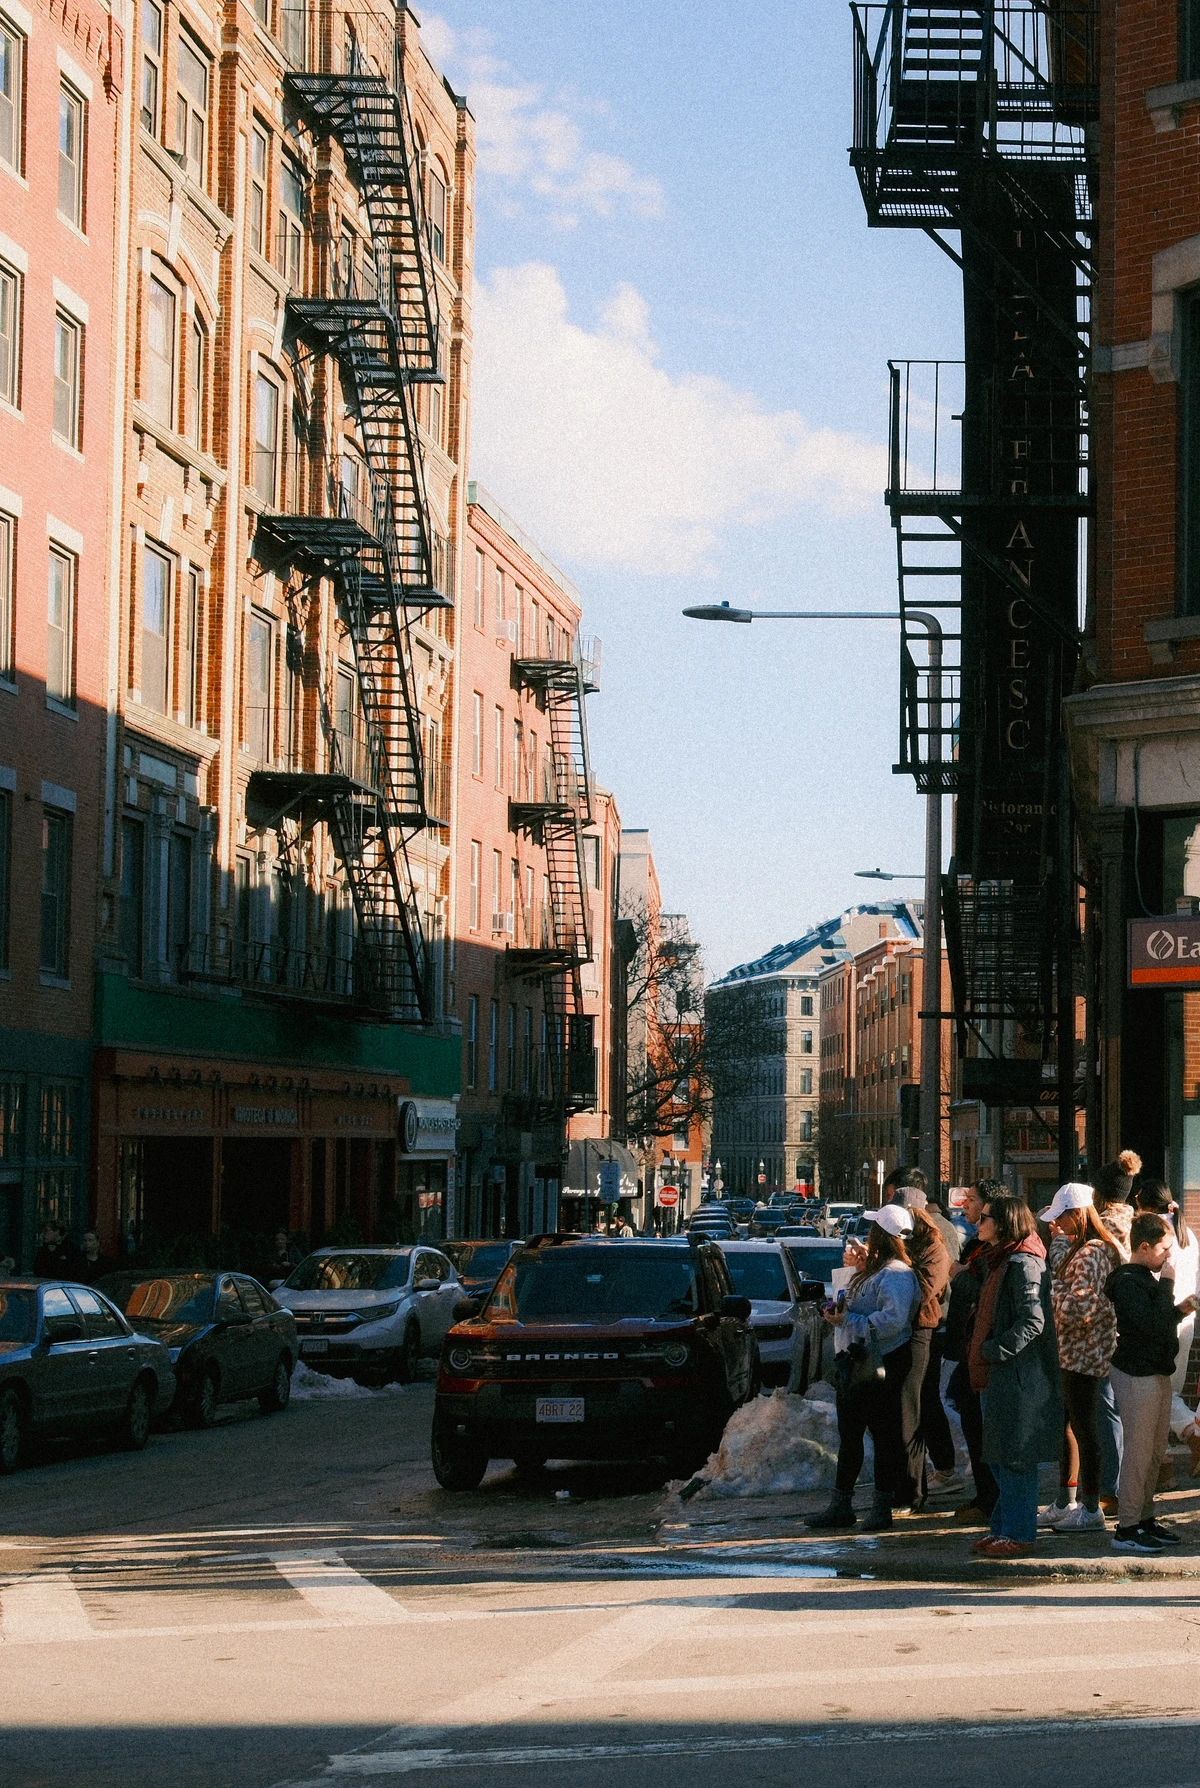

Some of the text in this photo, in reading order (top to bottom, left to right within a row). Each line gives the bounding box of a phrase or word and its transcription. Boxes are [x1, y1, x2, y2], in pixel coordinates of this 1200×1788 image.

[506, 1352, 619, 1361] BRONCO
[538, 1403, 582, 1416] 4BRT 22
